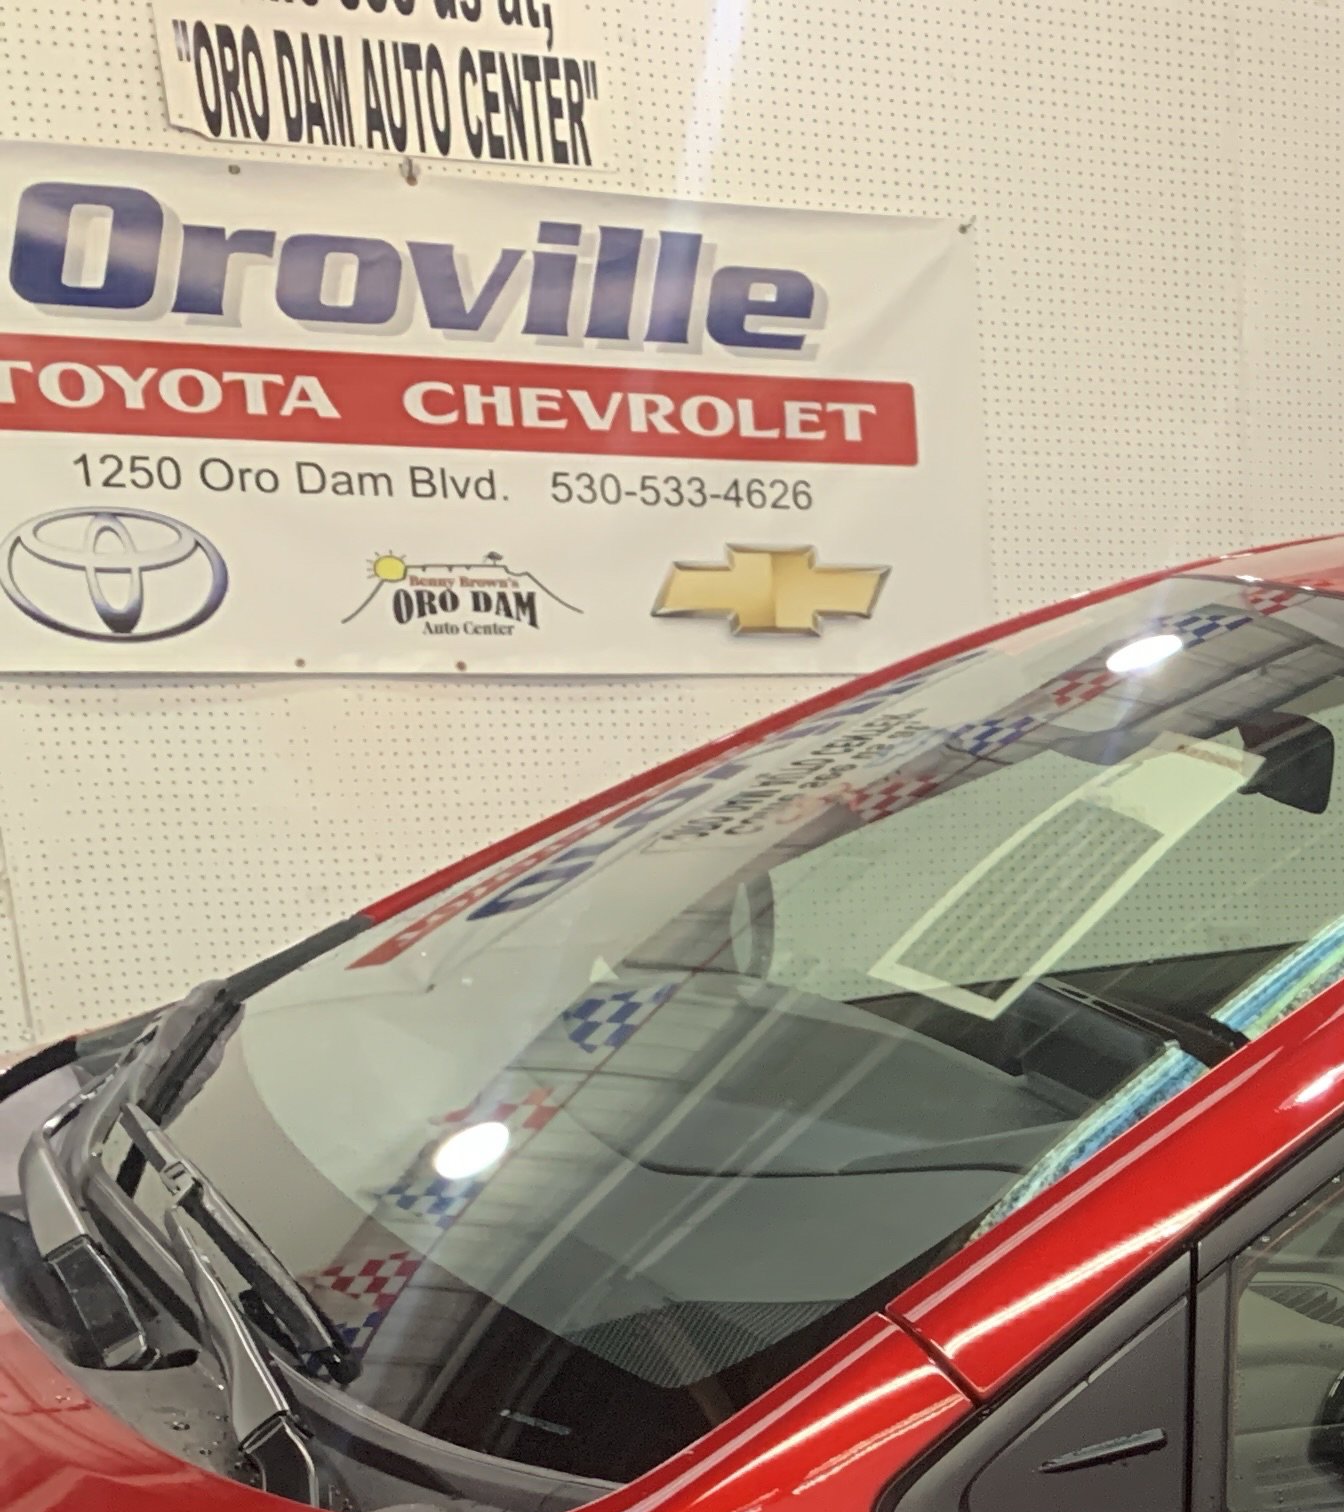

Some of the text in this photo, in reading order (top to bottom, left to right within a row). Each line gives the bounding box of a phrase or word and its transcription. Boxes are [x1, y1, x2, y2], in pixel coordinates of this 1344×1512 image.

[172, 19, 270, 142] "ORO
[274, 29, 356, 147] DAM
[361, 38, 451, 157] AUTO
[458, 46, 599, 166] CENTER"
[9, 181, 822, 352] Oroville
[0, 359, 877, 443] TOYOTA CHEVROLET
[73, 452, 814, 511] 1250 Oro Dam Blvd. 530-533-4626
[393, 588, 540, 630] ORO DAM
[408, 574, 519, 589] Benny Brown's
[422, 620, 515, 636] Auto Center
